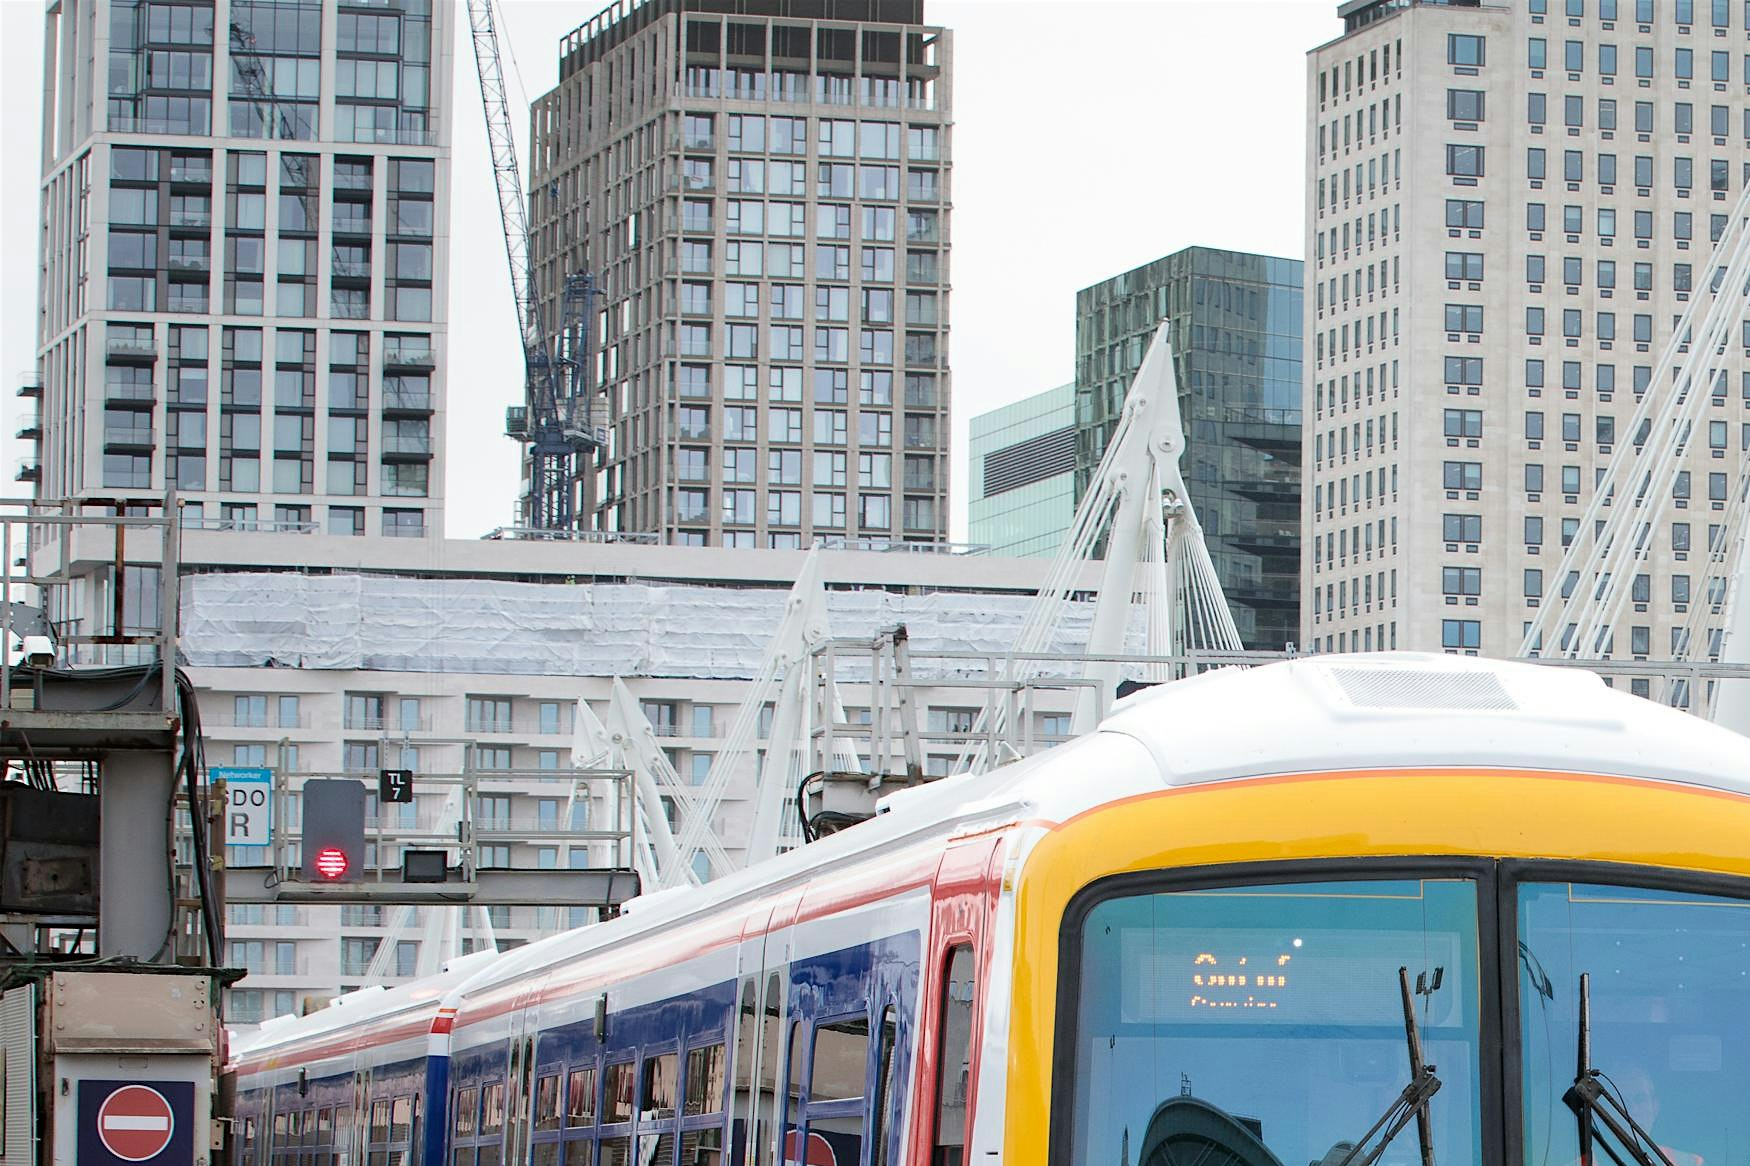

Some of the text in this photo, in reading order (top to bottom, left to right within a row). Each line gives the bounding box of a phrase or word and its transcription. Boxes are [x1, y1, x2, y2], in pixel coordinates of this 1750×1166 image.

[218, 771, 262, 779] Networker
[388, 772, 405, 785] TL
[392, 787, 401, 799] 7
[231, 812, 249, 837] R
